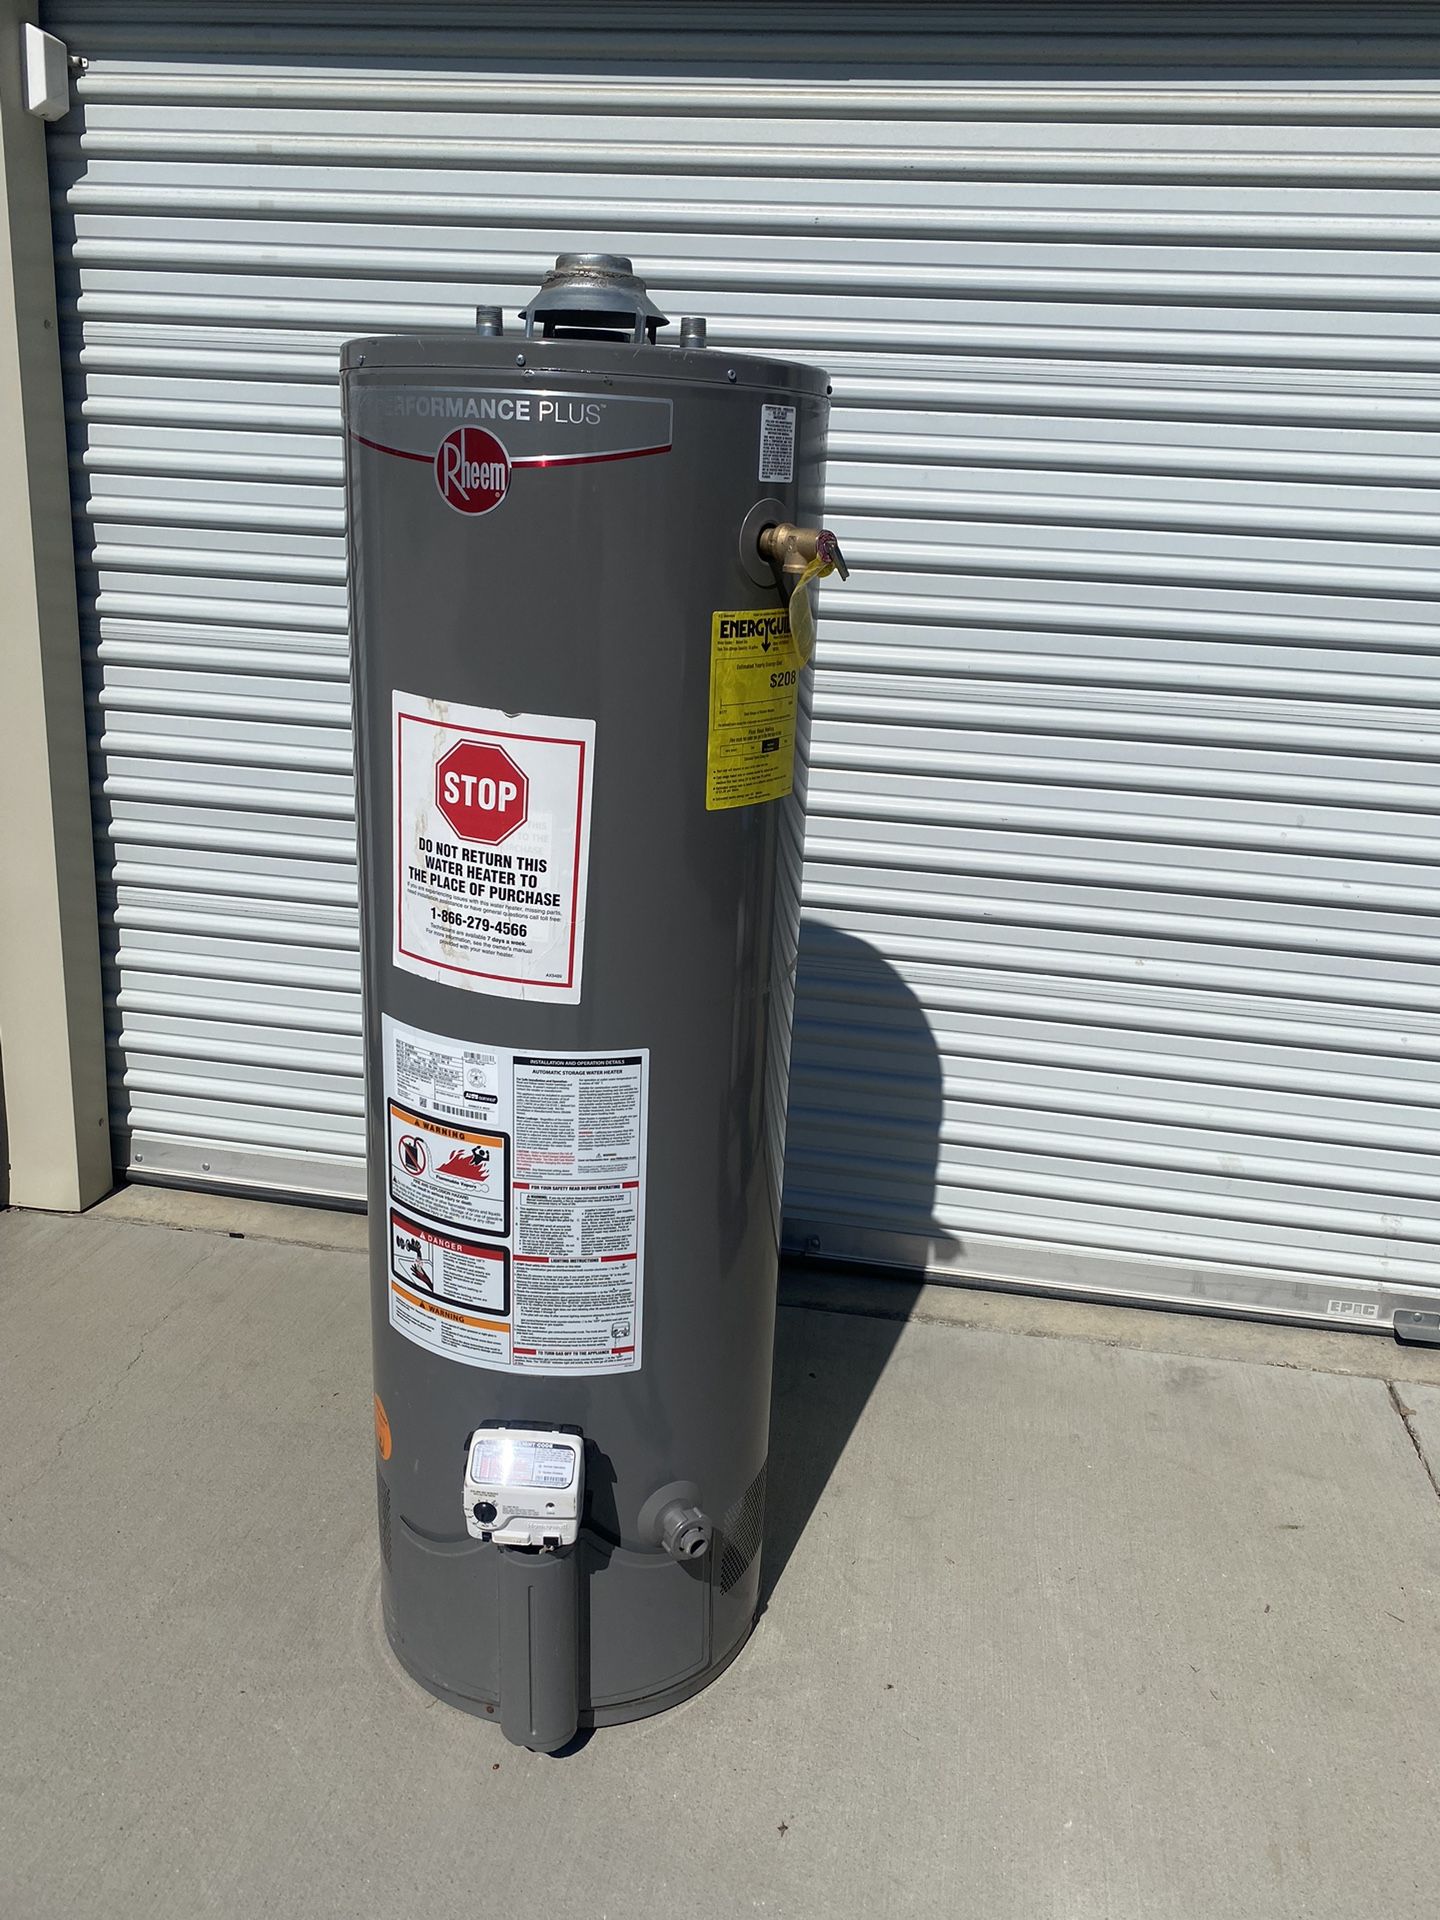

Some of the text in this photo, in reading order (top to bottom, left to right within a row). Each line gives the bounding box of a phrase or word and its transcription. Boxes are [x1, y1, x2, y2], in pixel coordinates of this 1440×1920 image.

[444, 429, 506, 501] Rheem
[769, 670, 796, 688] $208
[444, 771, 517, 812] STOP
[419, 837, 433, 853] DO
[436, 841, 458, 859] NOT
[462, 847, 512, 869] RETURN
[516, 856, 547, 873] THIS
[408, 865, 560, 907] THE PLACE OF PURCHASE
[425, 855, 537, 888] WATER HEATER TO
[430, 907, 527, 937] 1-866-279-4566
[423, 1121, 465, 1140] WARNING
[427, 1235, 463, 1252] DANGER
[428, 1305, 464, 1323] WARNING
